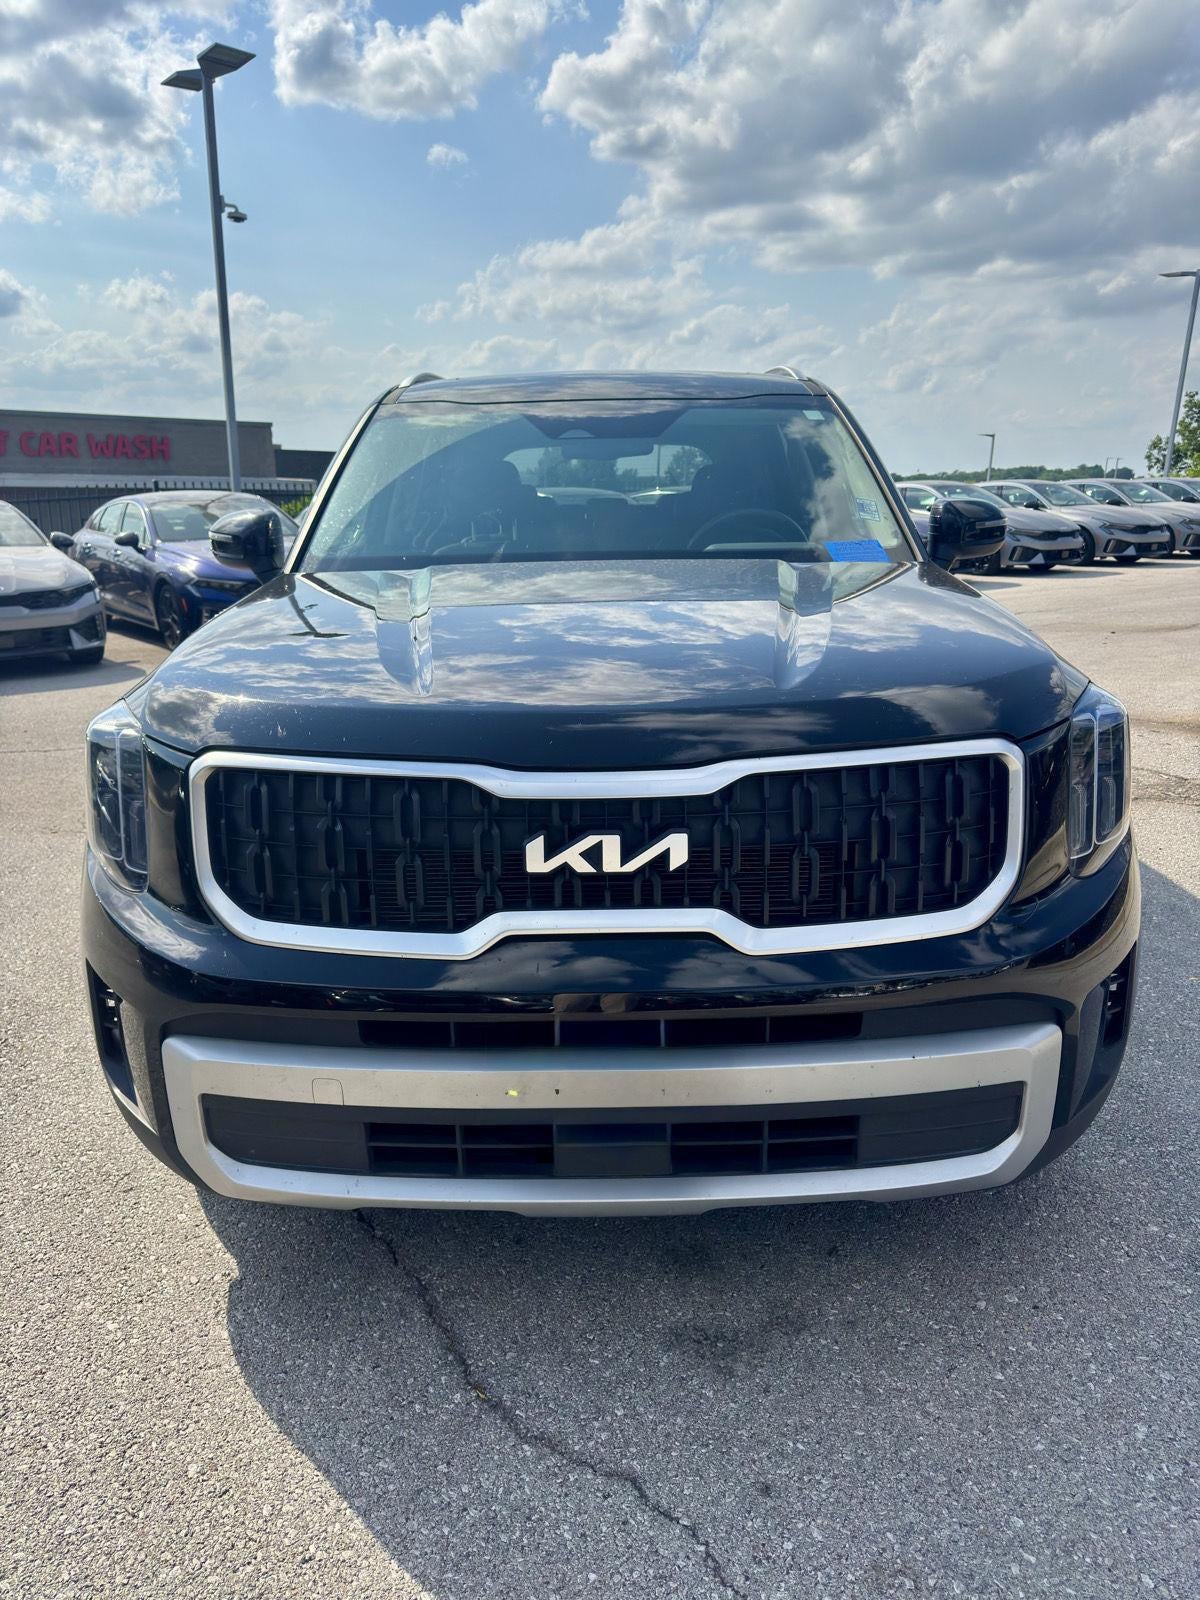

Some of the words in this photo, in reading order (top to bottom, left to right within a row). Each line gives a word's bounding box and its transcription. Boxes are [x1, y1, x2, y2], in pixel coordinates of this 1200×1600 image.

[20, 431, 80, 458] CAR
[87, 432, 171, 462] WASH
[525, 833, 689, 873] KIA
